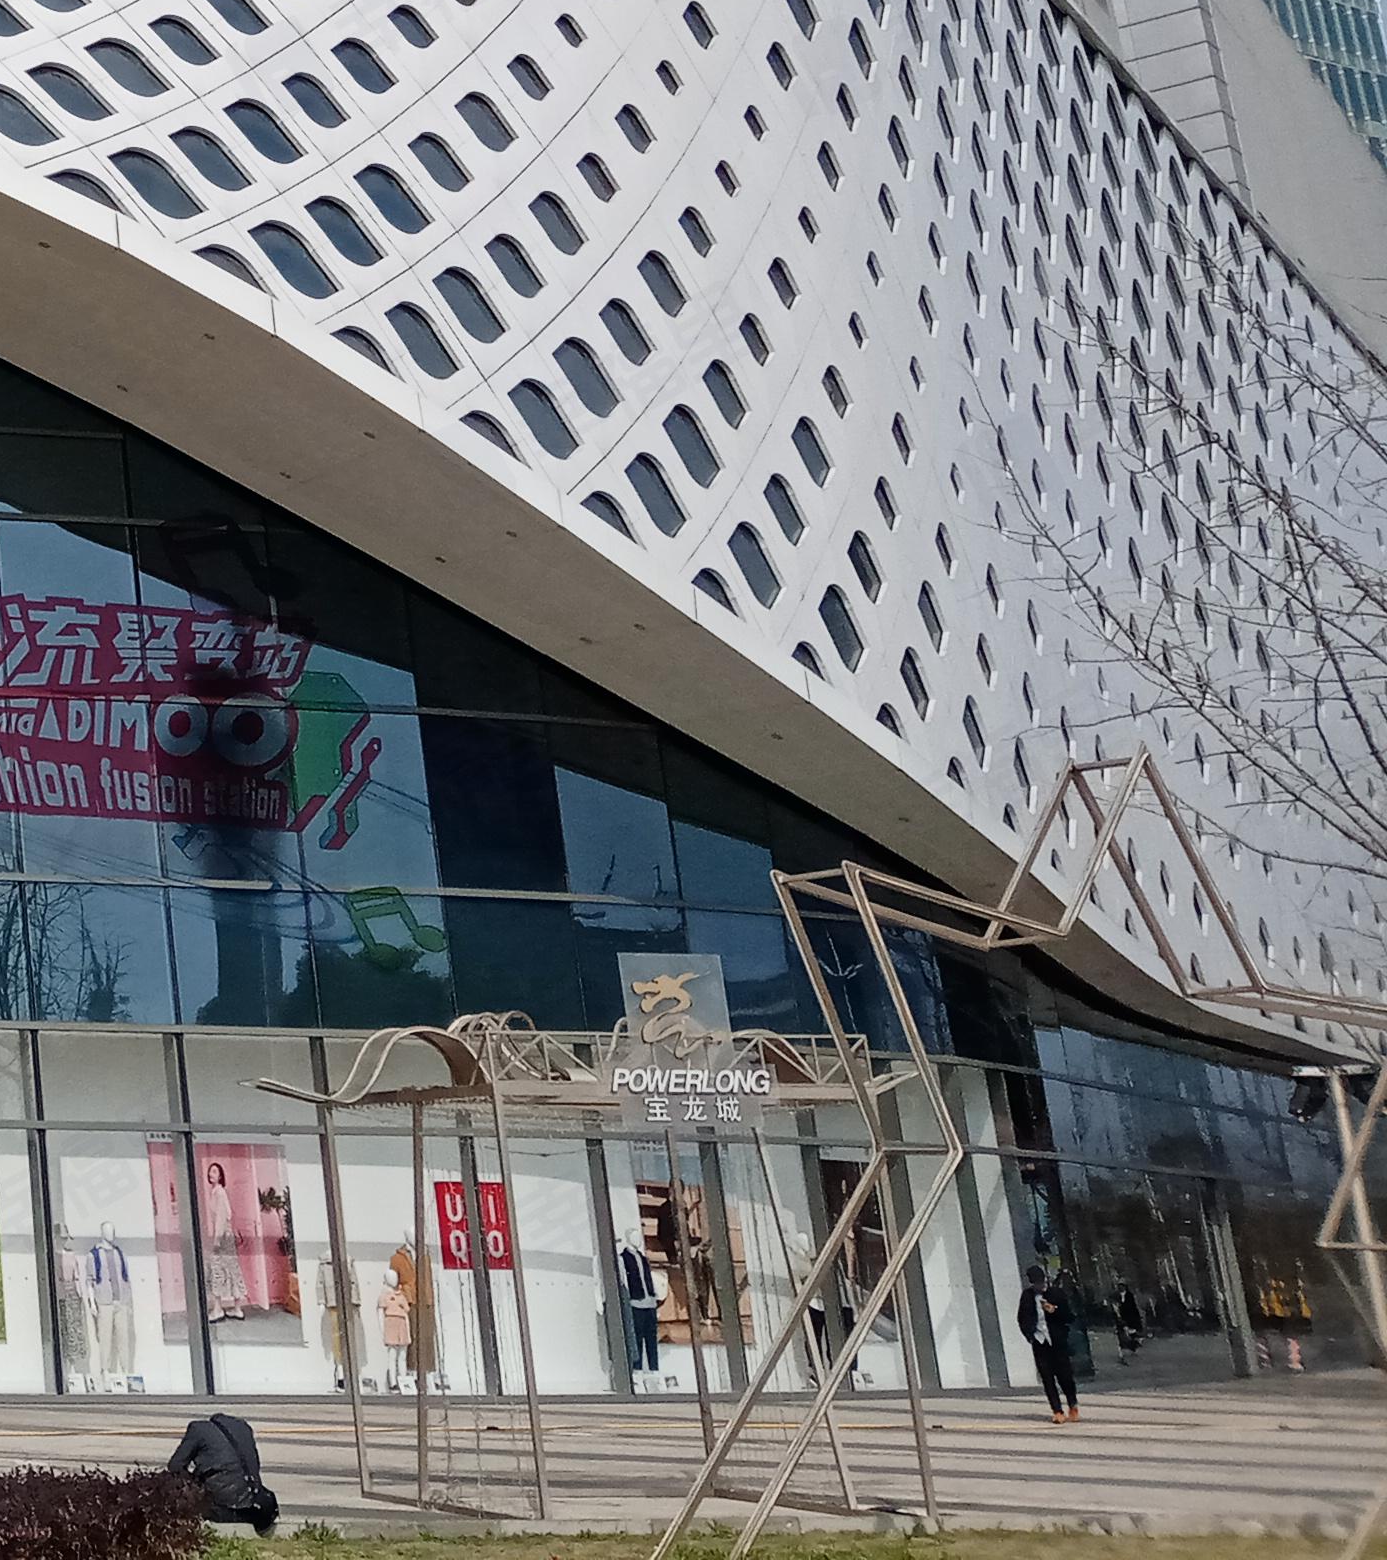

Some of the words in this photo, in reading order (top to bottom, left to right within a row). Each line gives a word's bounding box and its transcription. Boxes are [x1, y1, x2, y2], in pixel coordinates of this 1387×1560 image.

[612, 1067, 772, 1095] POWERLONG
[643, 1096, 743, 1123] 宝龙城
[444, 1193, 500, 1224] UI
[448, 1229, 505, 1264] QO
